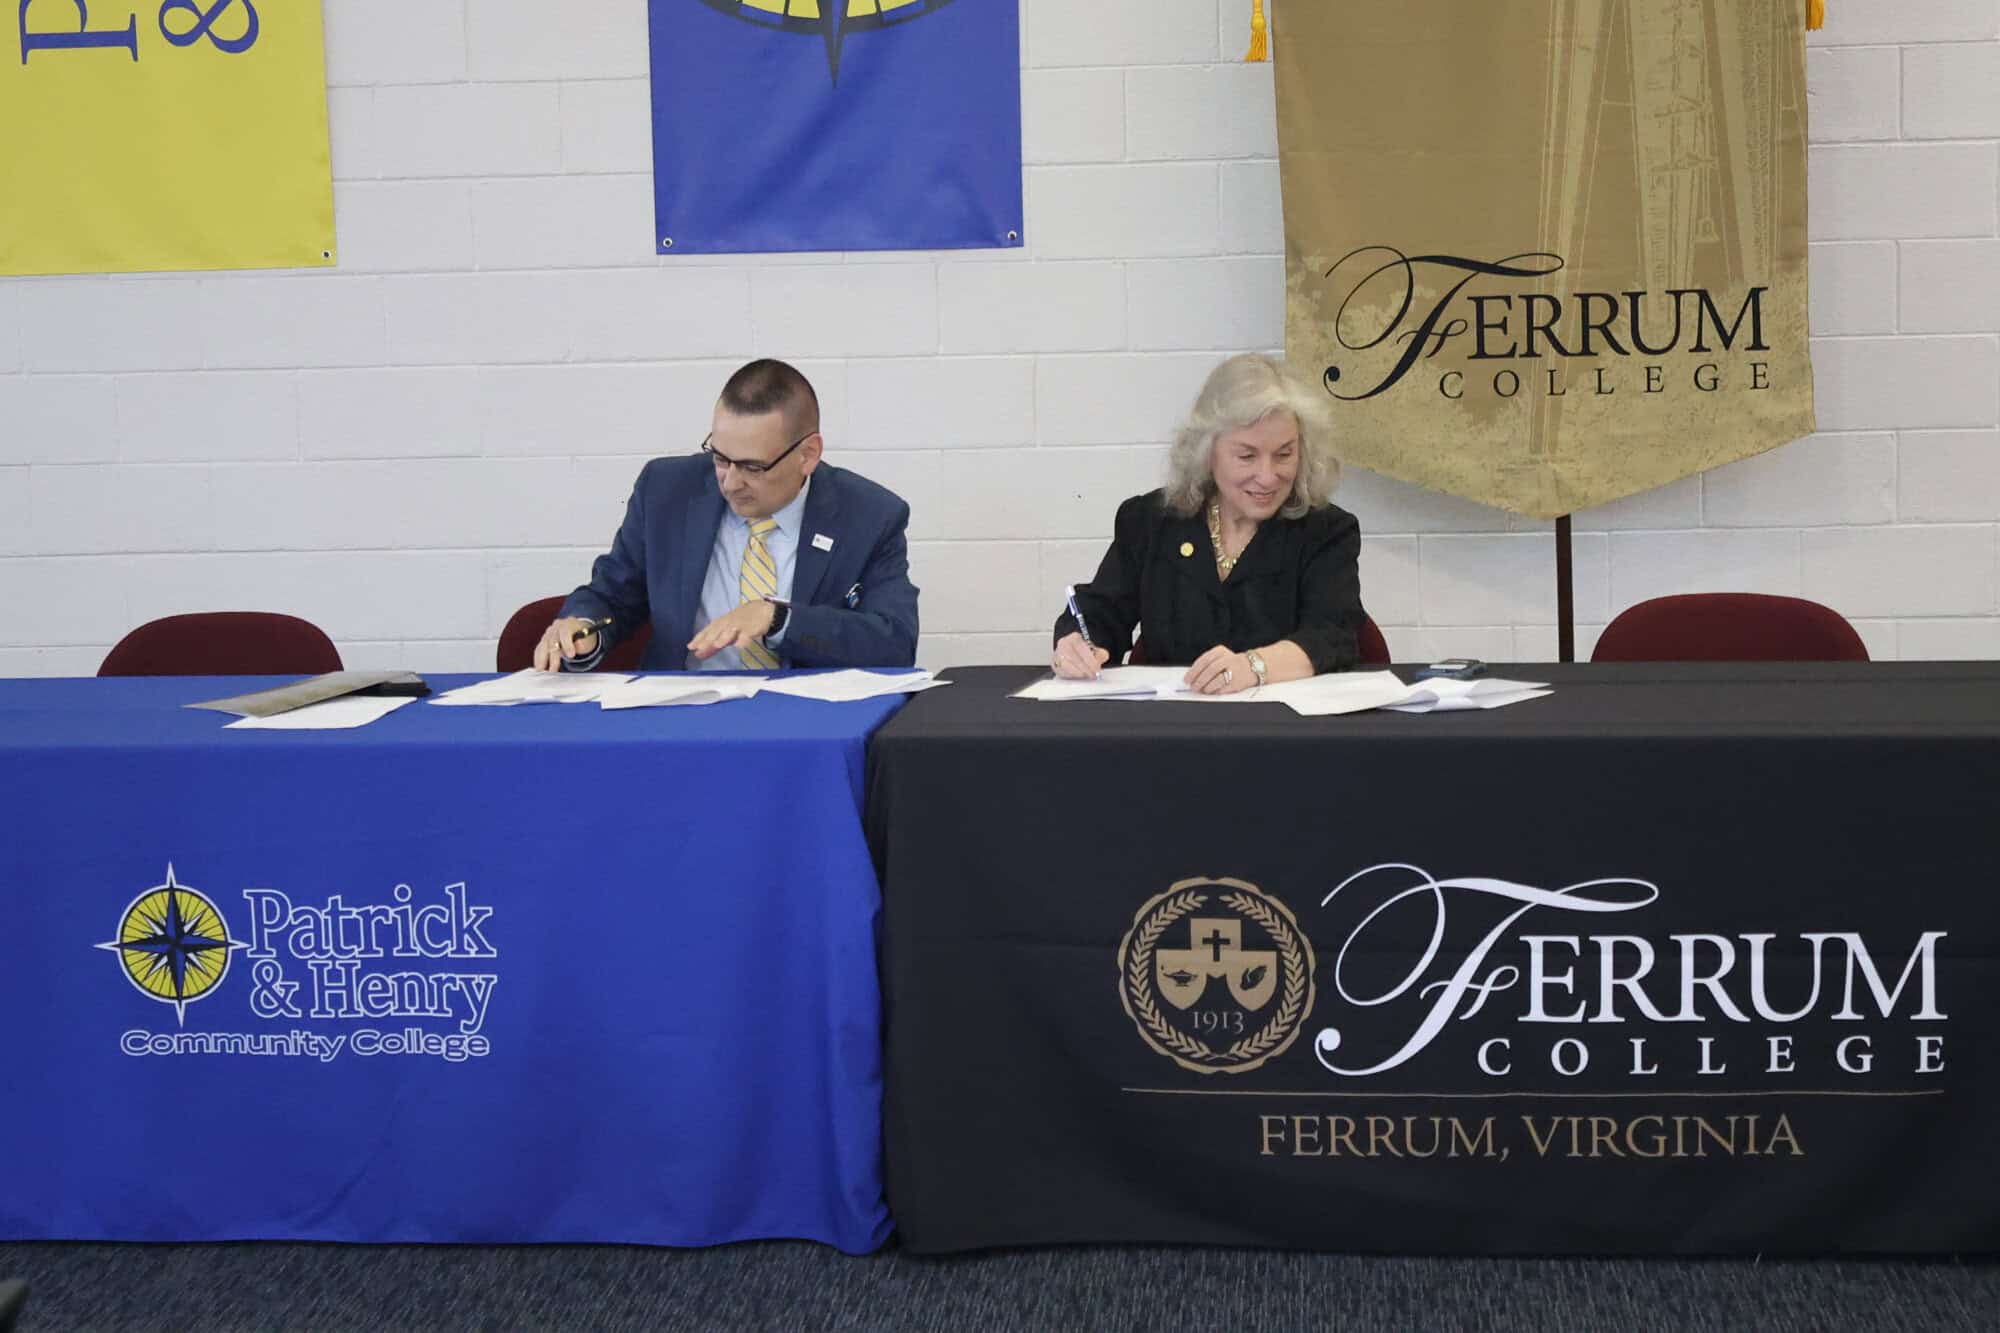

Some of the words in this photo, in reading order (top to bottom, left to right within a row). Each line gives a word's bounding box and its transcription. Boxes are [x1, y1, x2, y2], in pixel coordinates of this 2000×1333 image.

[1323, 245, 1770, 401] FERRUM
[1439, 362, 1770, 400] COLLEGE
[243, 881, 497, 959] Patrick
[1315, 863, 1948, 1076] FERRUM
[249, 959, 301, 1019] &
[308, 960, 498, 1033] Henry
[120, 1029, 347, 1061] Community
[351, 1028, 490, 1061] College
[1192, 1010, 1245, 1034] 1913
[1478, 1036, 1945, 1076] COLLEGE
[1259, 1114, 1511, 1160] FERRUM,
[1521, 1114, 1804, 1158] VIRGINIA
